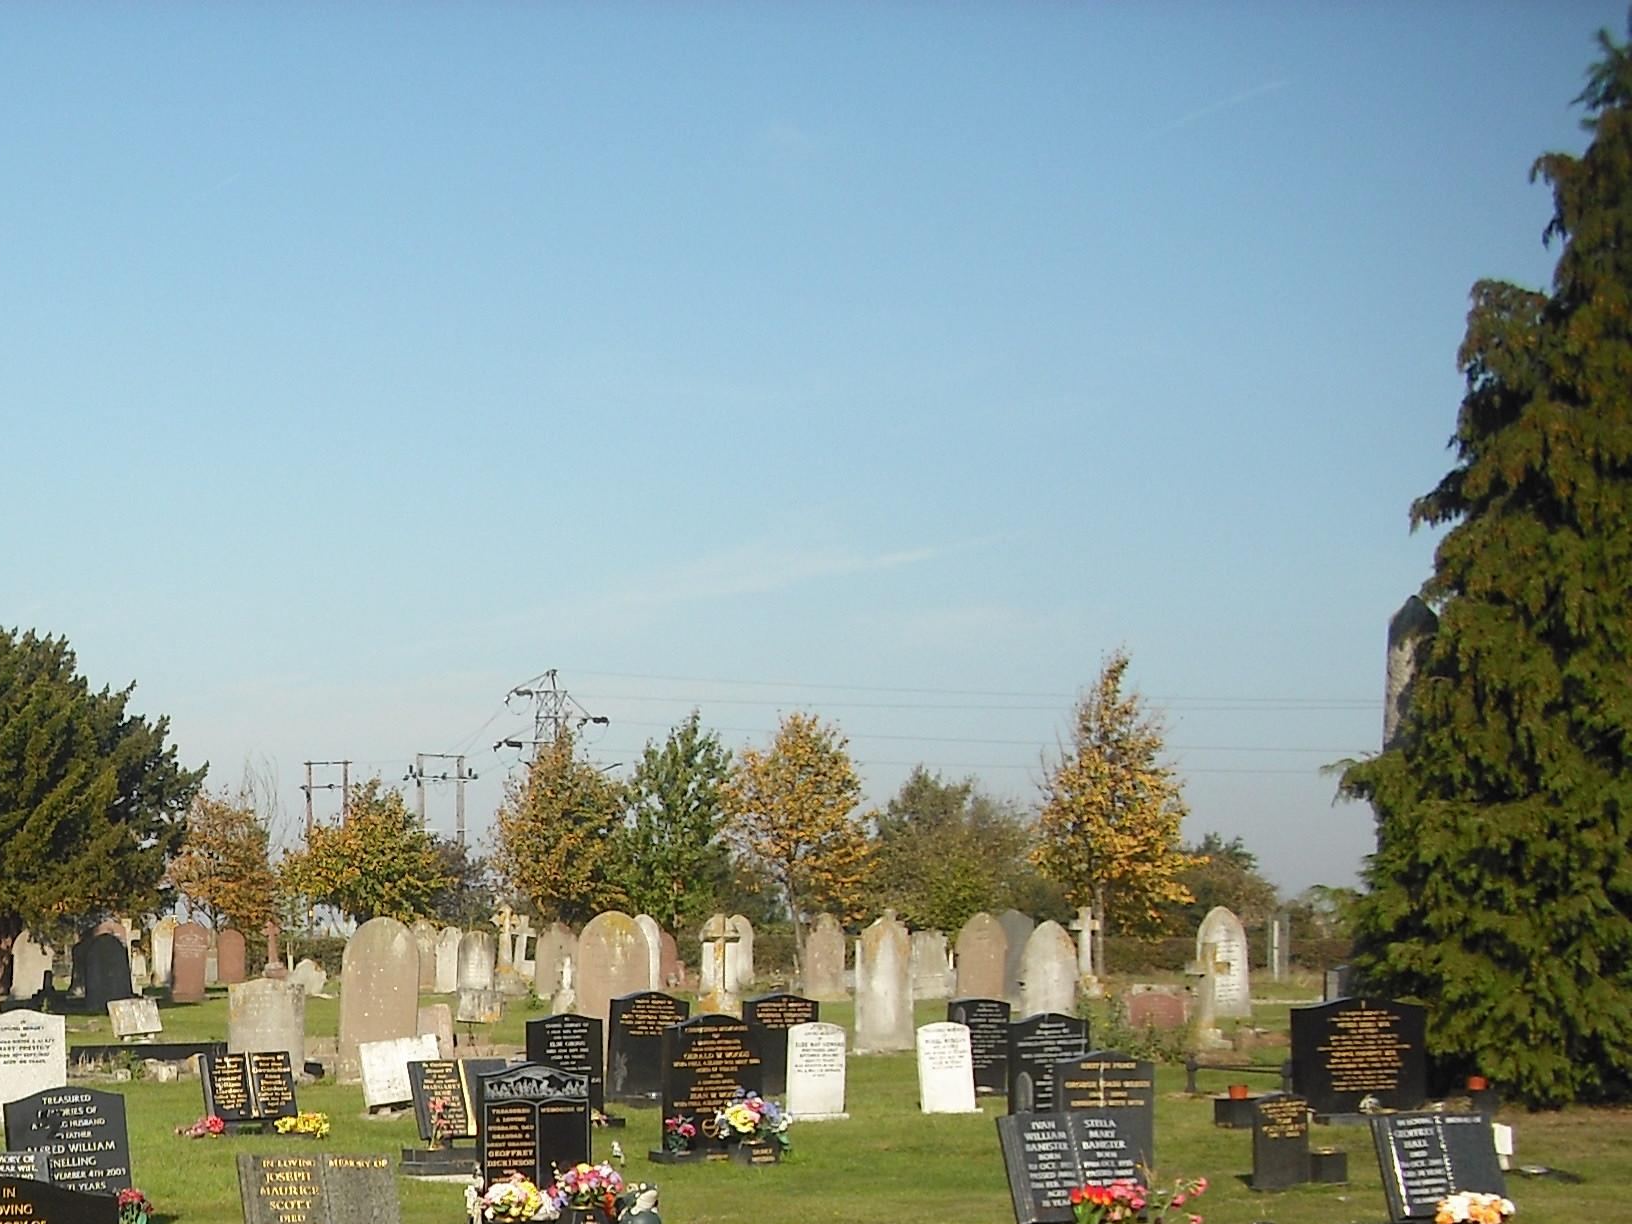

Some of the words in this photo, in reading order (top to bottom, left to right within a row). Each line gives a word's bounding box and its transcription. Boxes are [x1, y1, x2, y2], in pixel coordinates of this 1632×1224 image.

[41, 1094, 92, 1105] TREASURED
[86, 1105, 98, 1115] OF
[68, 1117, 106, 1129] HUSBAND
[1031, 1121, 1056, 1130] IVAN
[1083, 1119, 1117, 1129] STELLA
[65, 1130, 93, 1140] FATHER
[1023, 1131, 1067, 1141] WILLIAM
[67, 1140, 116, 1154] WILLIAM
[1025, 1142, 1069, 1152] BANISTER
[1403, 1139, 1430, 1149] HALL
[488, 1149, 534, 1157] GEOFFREY
[22, 1155, 36, 1164] OF
[262, 1159, 274, 1168] IN
[277, 1159, 315, 1168] LOVING
[328, 1159, 370, 1168] MEMORY
[373, 1159, 388, 1168] OF
[264, 1171, 311, 1183] JOSEPH
[77, 1181, 106, 1192] YEARS
[259, 1186, 320, 1196] MAURICE
[2, 1186, 17, 1199] IN
[269, 1200, 312, 1210] SCOTT
[279, 1214, 306, 1223] DIED
